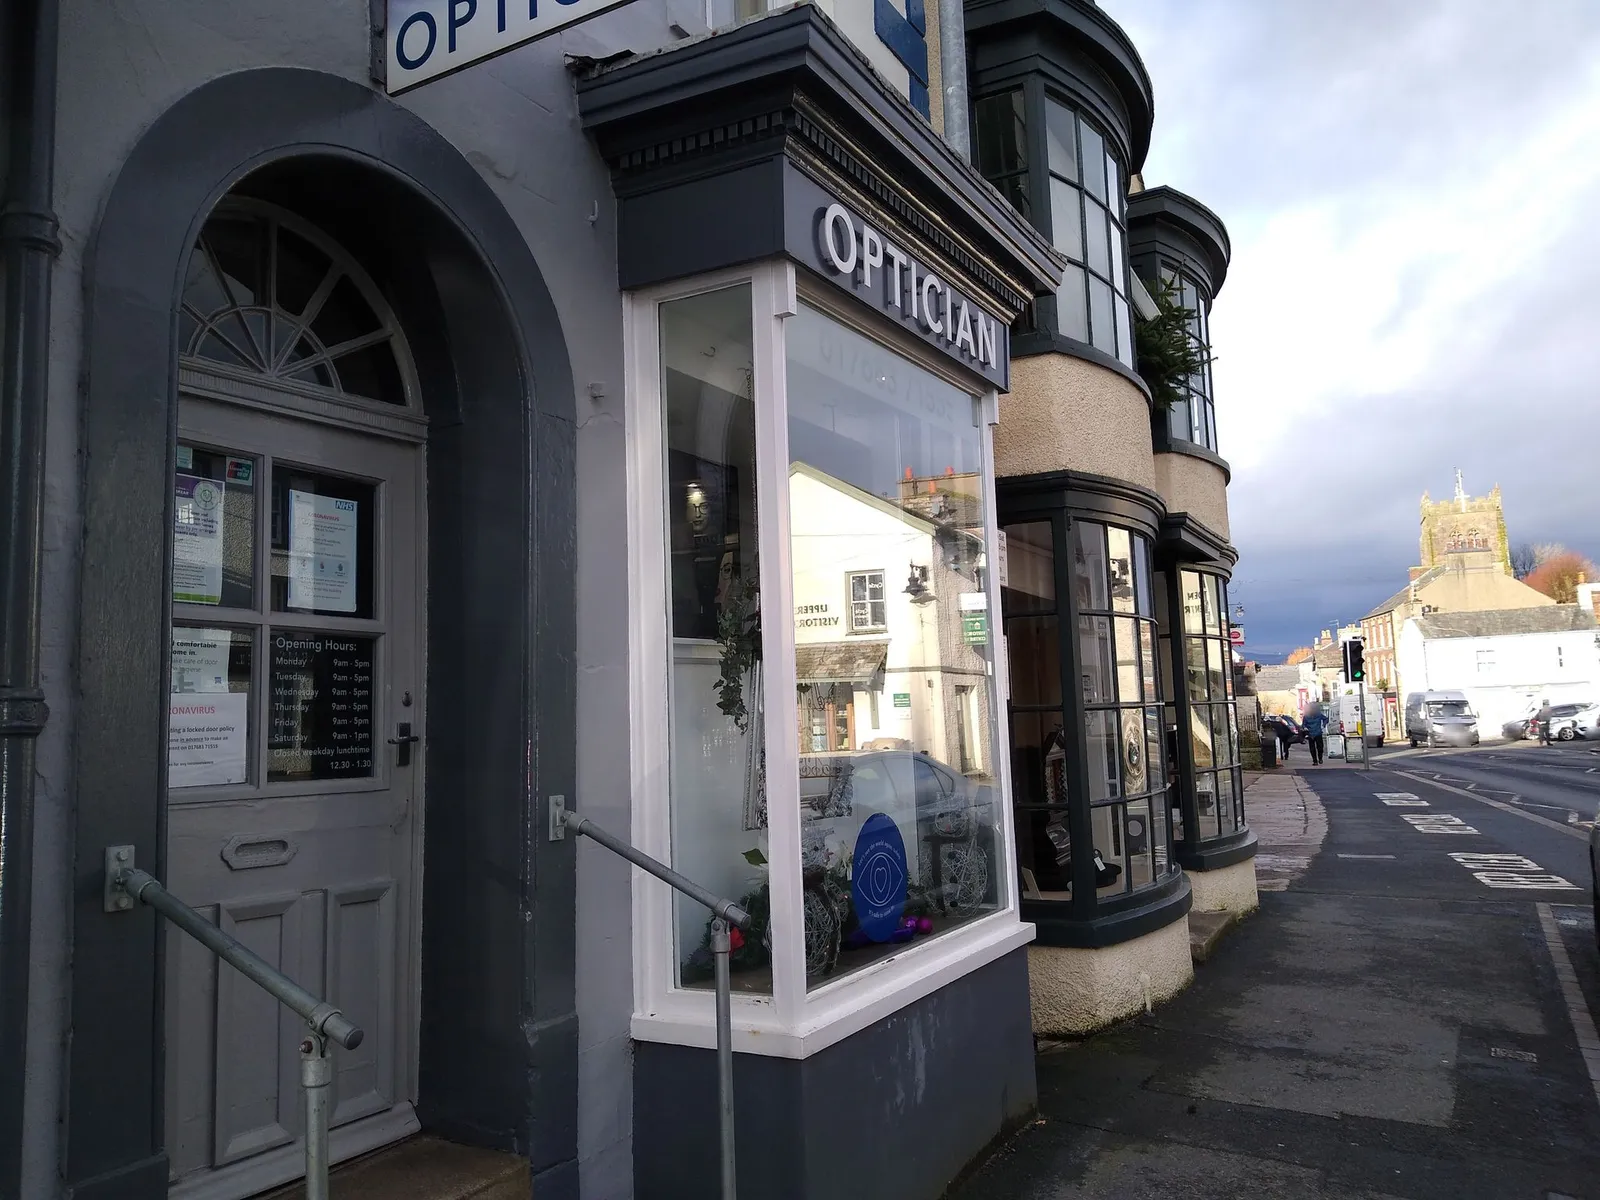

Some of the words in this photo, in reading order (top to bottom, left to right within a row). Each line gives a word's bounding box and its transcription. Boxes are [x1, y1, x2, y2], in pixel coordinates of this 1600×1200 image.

[824, 203, 996, 370] OPTICIAN
[336, 501, 354, 511] NHS
[176, 641, 217, 649] comfortable
[276, 637, 322, 653] Opening
[325, 640, 357, 651] Hours:
[275, 657, 307, 668] Monday
[333, 659, 349, 667] 9am
[354, 659, 370, 669] 5pm
[275, 672, 306, 683] Tuesday
[332, 673, 348, 681] 9am
[354, 673, 370, 682] 5pm
[275, 687, 319, 698] Wednesday
[331, 687, 347, 696] 9am
[353, 687, 369, 698] 5pm
[274, 702, 310, 713] Thursday
[331, 702, 347, 711] 9am
[352, 702, 369, 712] 5pm
[274, 717, 299, 728] Friday
[332, 717, 348, 725] 9am
[353, 717, 369, 727] 5pm
[219, 725, 235, 733] policy
[274, 733, 309, 743] Saturday
[332, 732, 348, 740] 9am
[354, 731, 369, 741] 1pm
[274, 749, 300, 758] Closed
[303, 748, 335, 756] weekday
[336, 746, 370, 755] lunchtime
[330, 761, 350, 770] 12.30
[356, 760, 372, 768] 1.30
